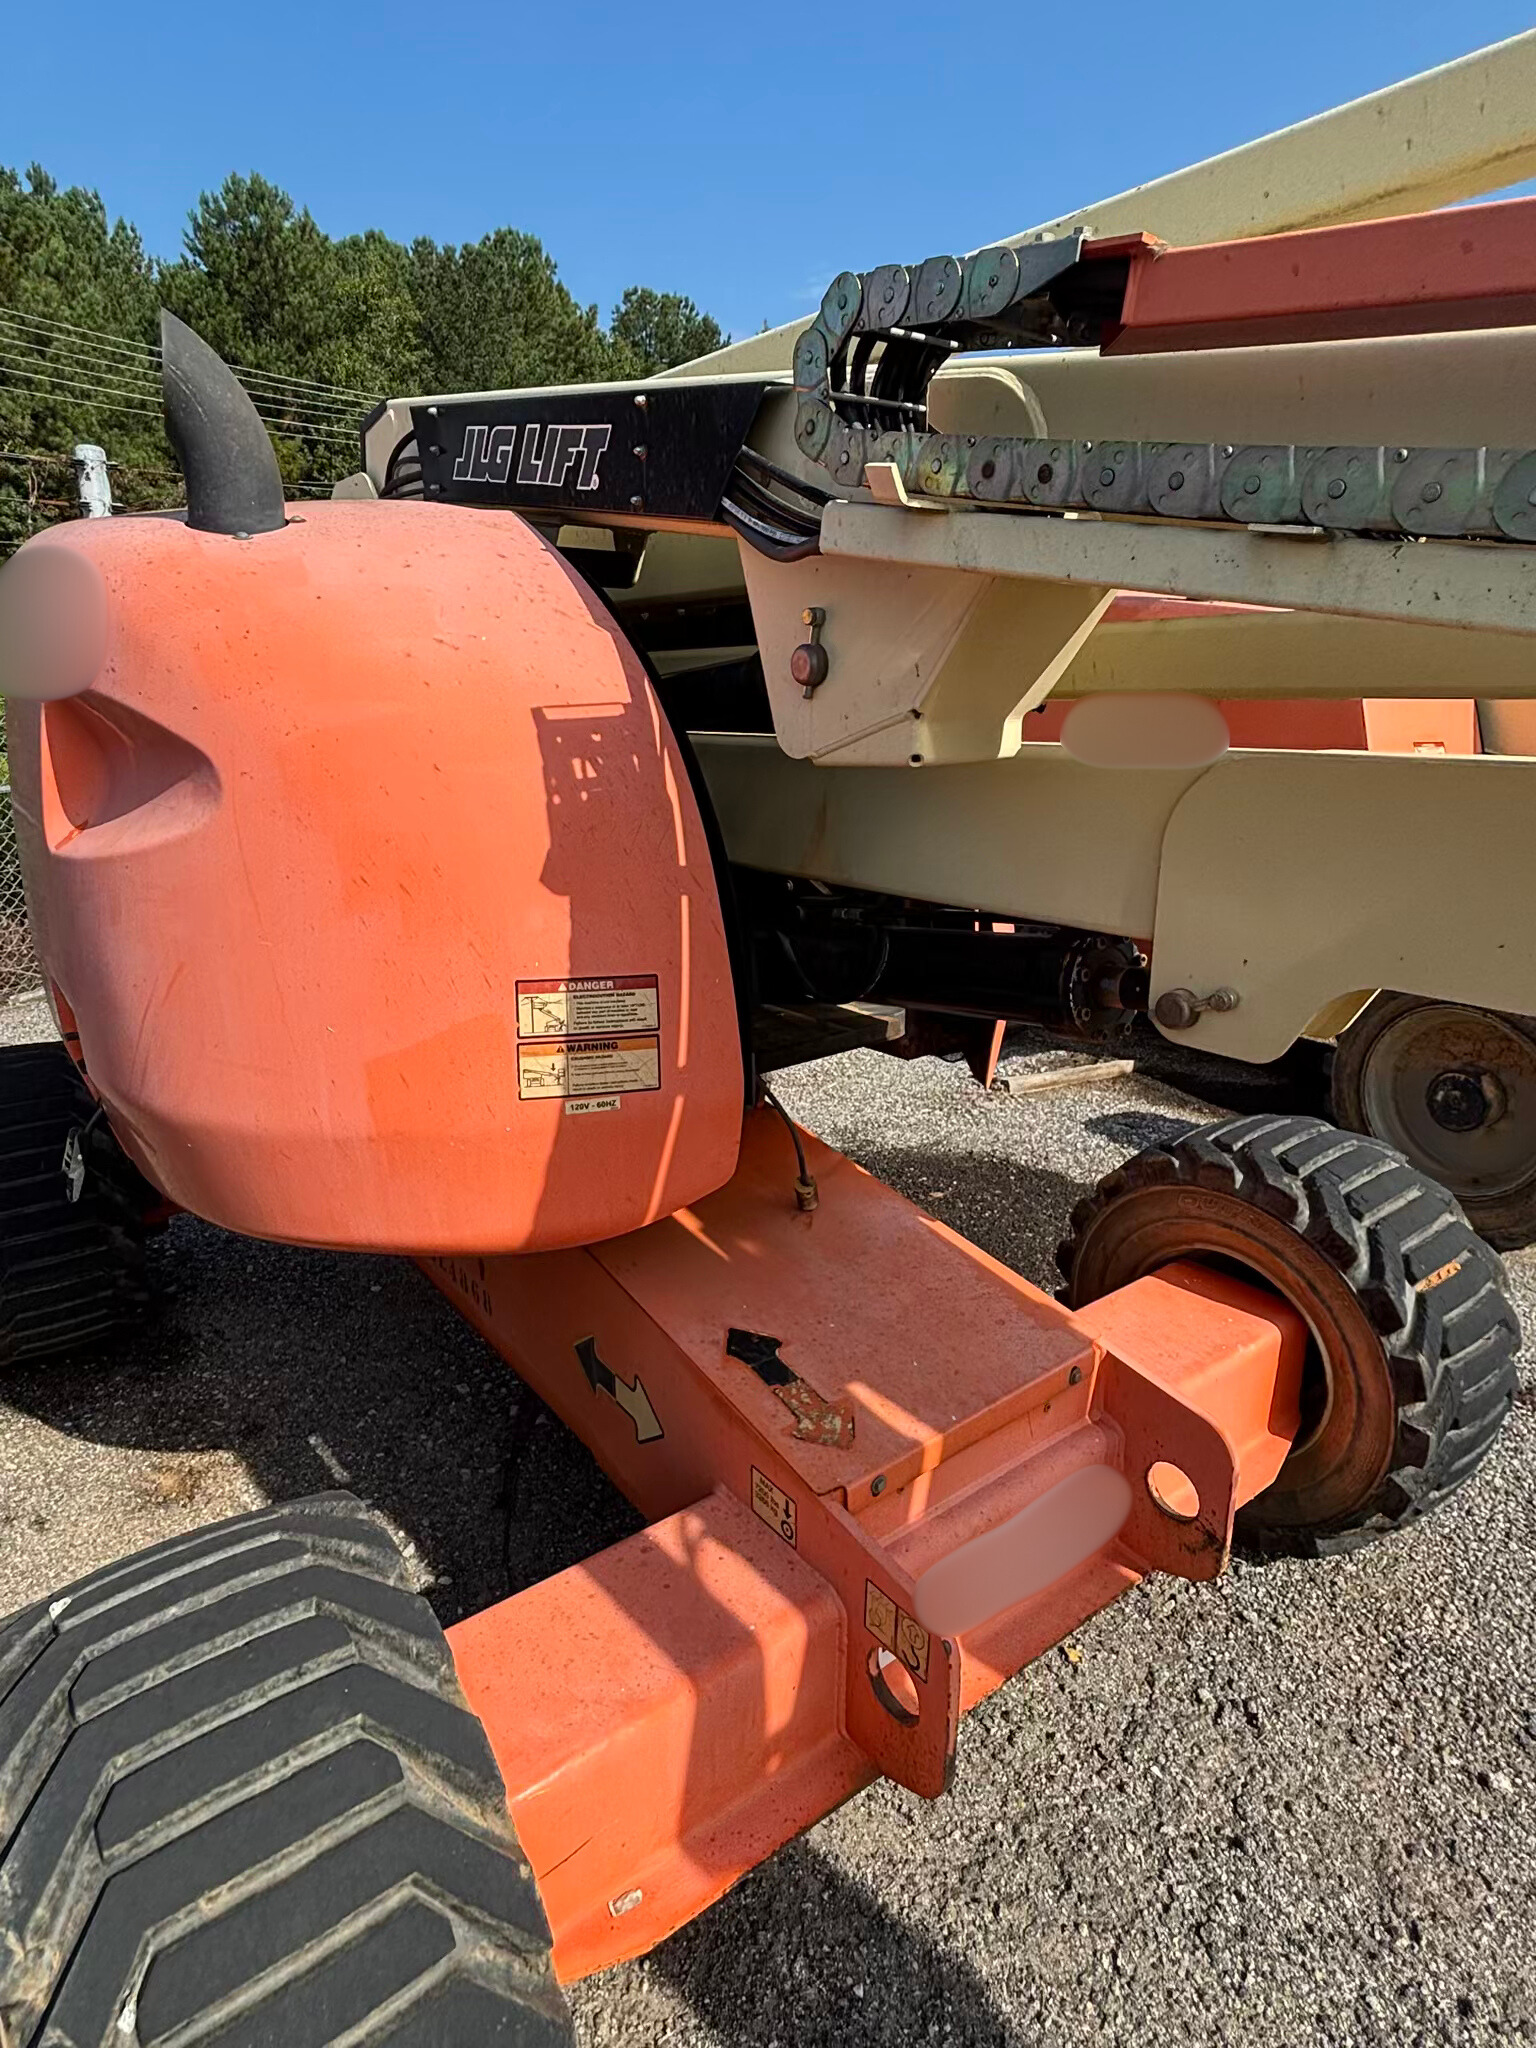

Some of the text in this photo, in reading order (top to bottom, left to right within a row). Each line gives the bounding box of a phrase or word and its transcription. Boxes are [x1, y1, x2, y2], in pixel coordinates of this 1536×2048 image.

[453, 425, 517, 483] JLG
[568, 980, 614, 991] DANGER
[566, 1041, 618, 1053] WARNING
[569, 1103, 590, 1111] 120V
[596, 1100, 617, 1109] 60HZ
